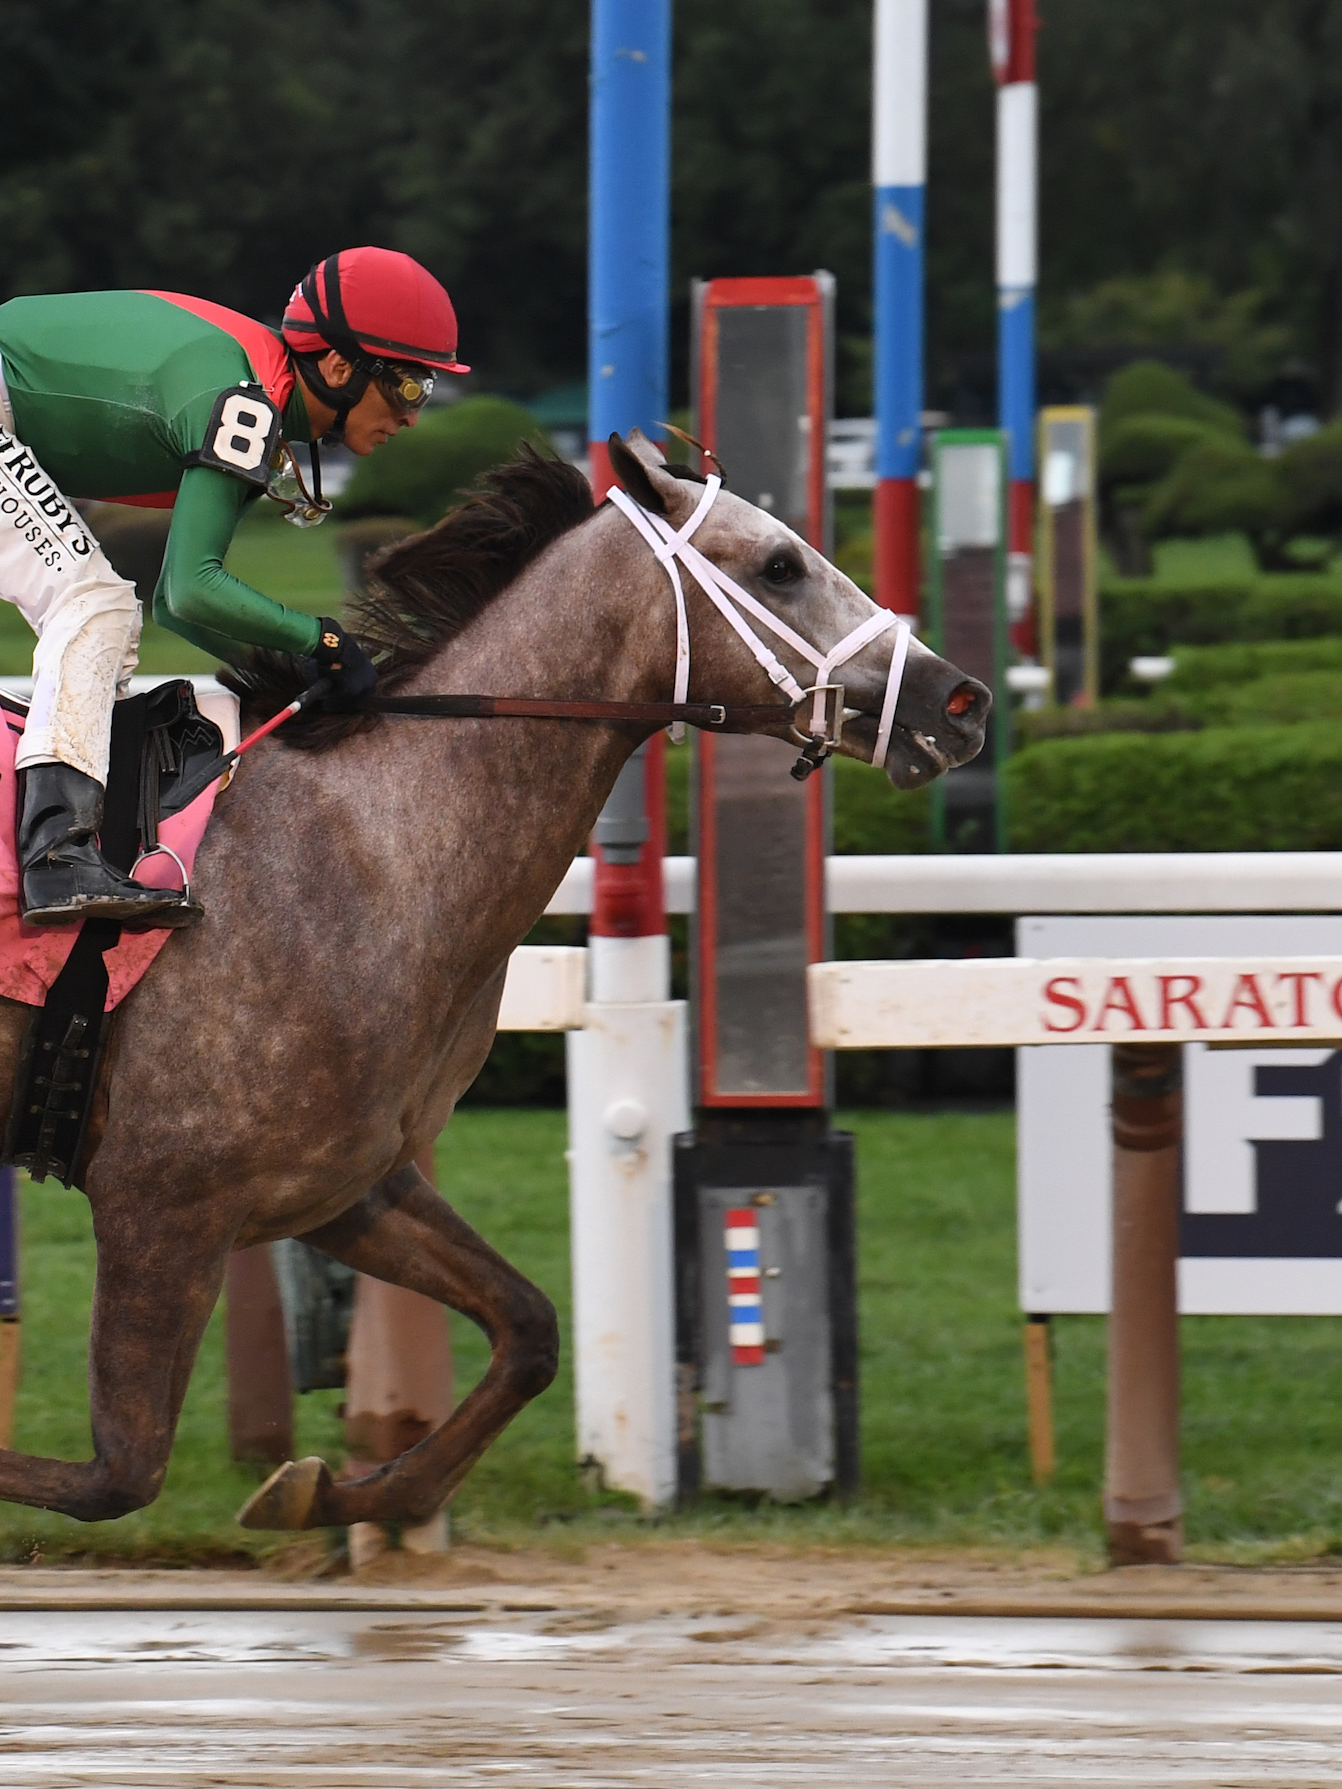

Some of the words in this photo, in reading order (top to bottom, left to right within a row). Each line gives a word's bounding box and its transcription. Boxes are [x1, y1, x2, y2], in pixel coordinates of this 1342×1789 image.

[212, 393, 274, 471] 8
[1042, 971, 1342, 1033] SARAT
[1183, 1041, 1342, 1215] F
